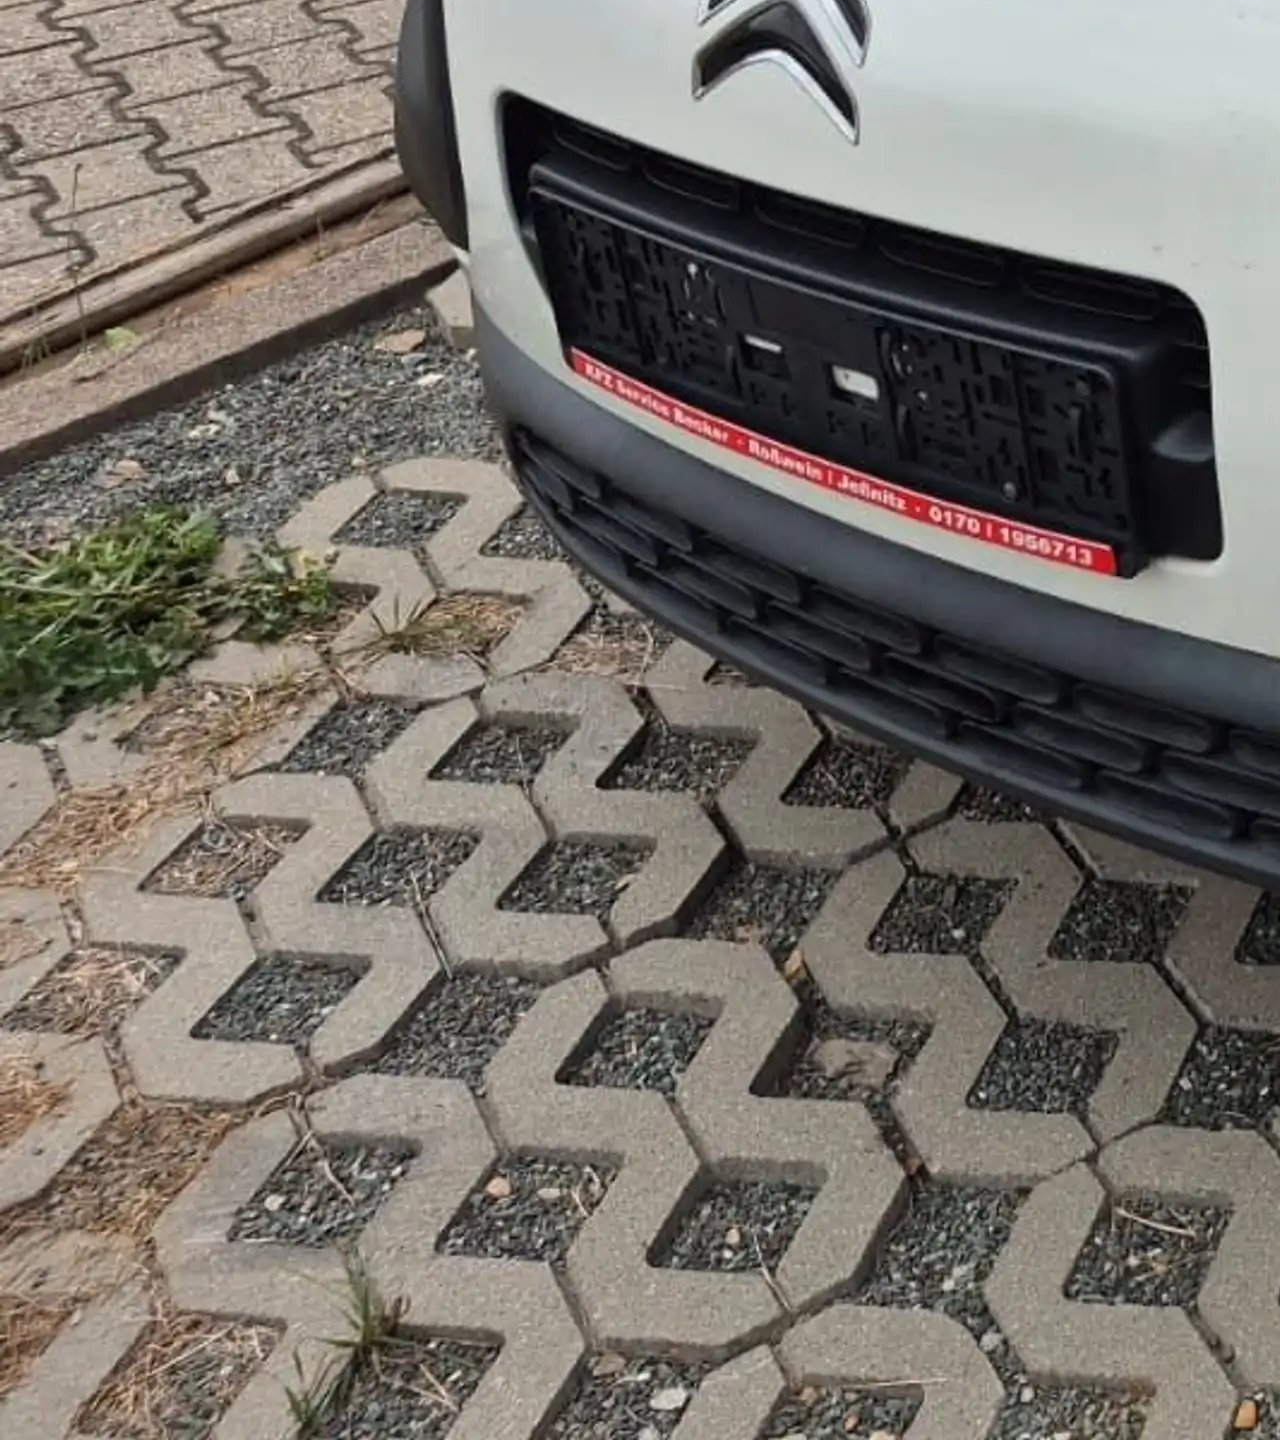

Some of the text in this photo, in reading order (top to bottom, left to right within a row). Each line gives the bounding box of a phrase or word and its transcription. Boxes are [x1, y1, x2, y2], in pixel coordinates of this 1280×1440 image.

[584, 363, 613, 389] KFZ
[616, 379, 669, 418] Service
[673, 407, 730, 445] Becker
[928, 504, 981, 536] 0170
